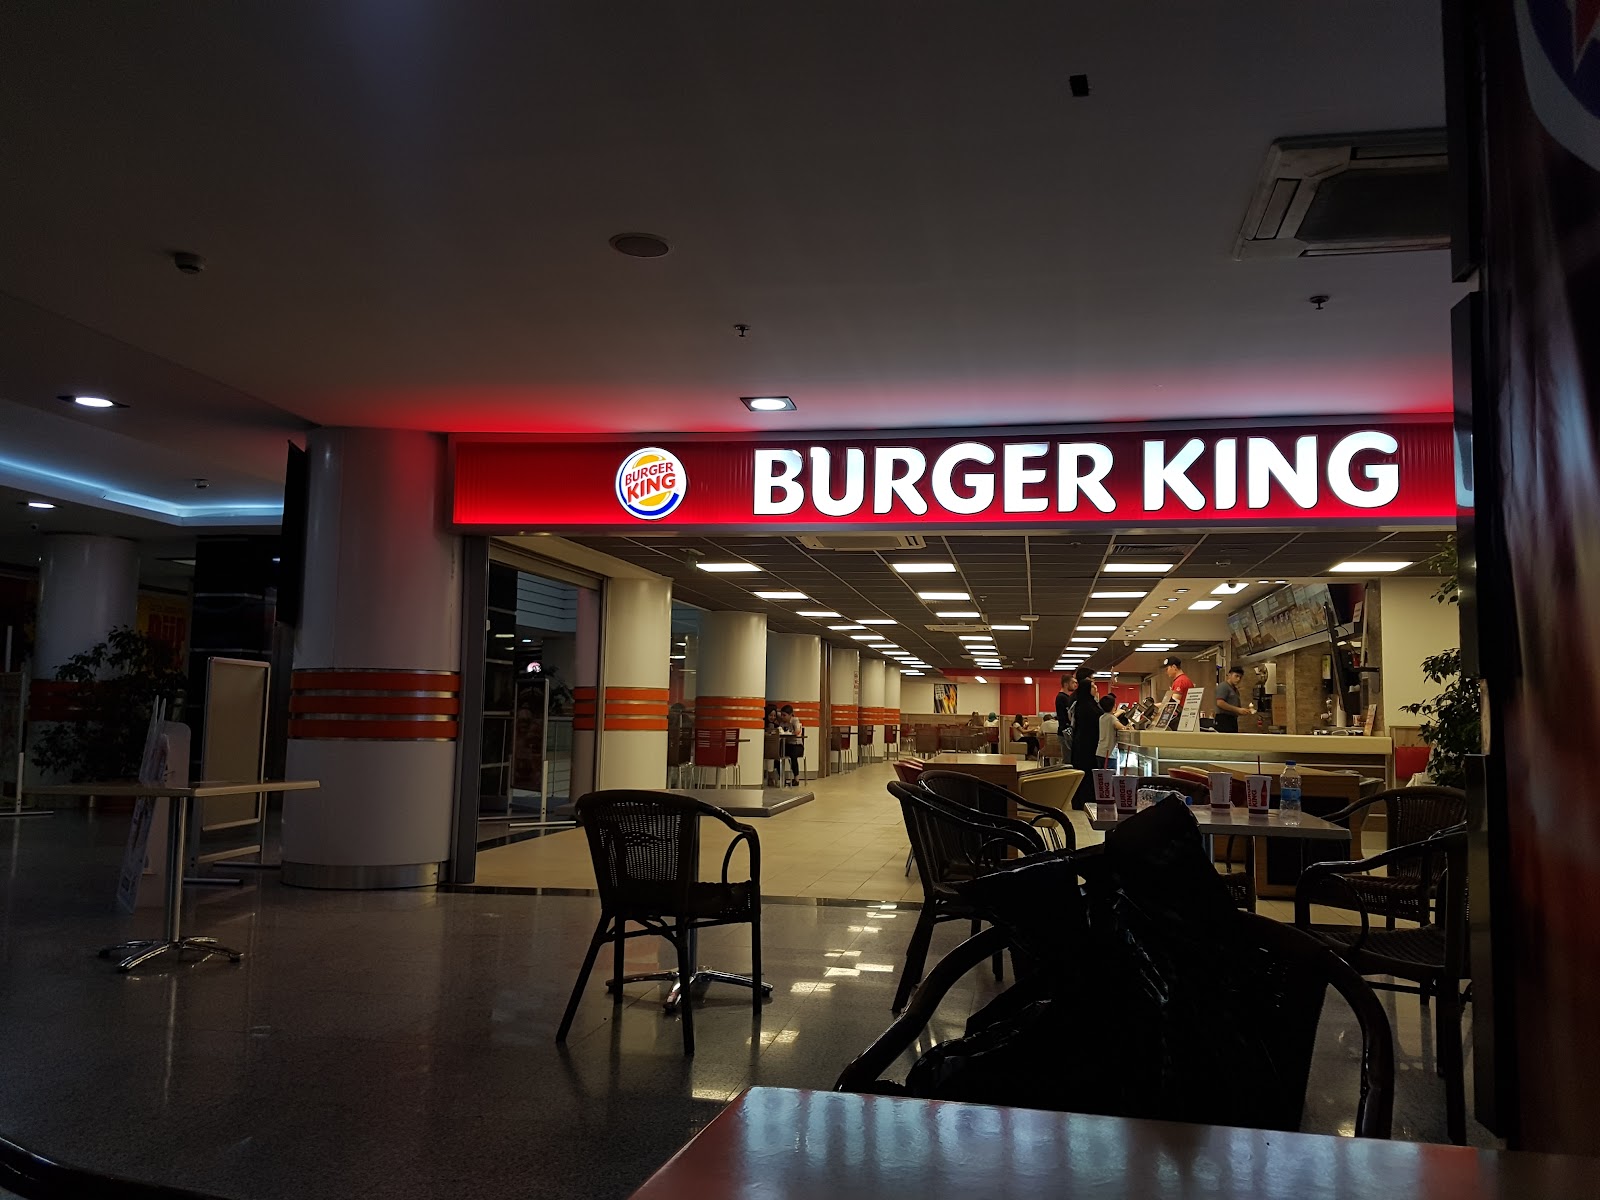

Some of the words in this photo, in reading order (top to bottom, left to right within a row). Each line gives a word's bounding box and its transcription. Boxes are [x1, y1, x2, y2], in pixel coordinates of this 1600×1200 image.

[625, 461, 674, 487] BURGER
[627, 472, 676, 505] KING
[752, 441, 1117, 516] BURGER
[1143, 430, 1400, 511] KING
